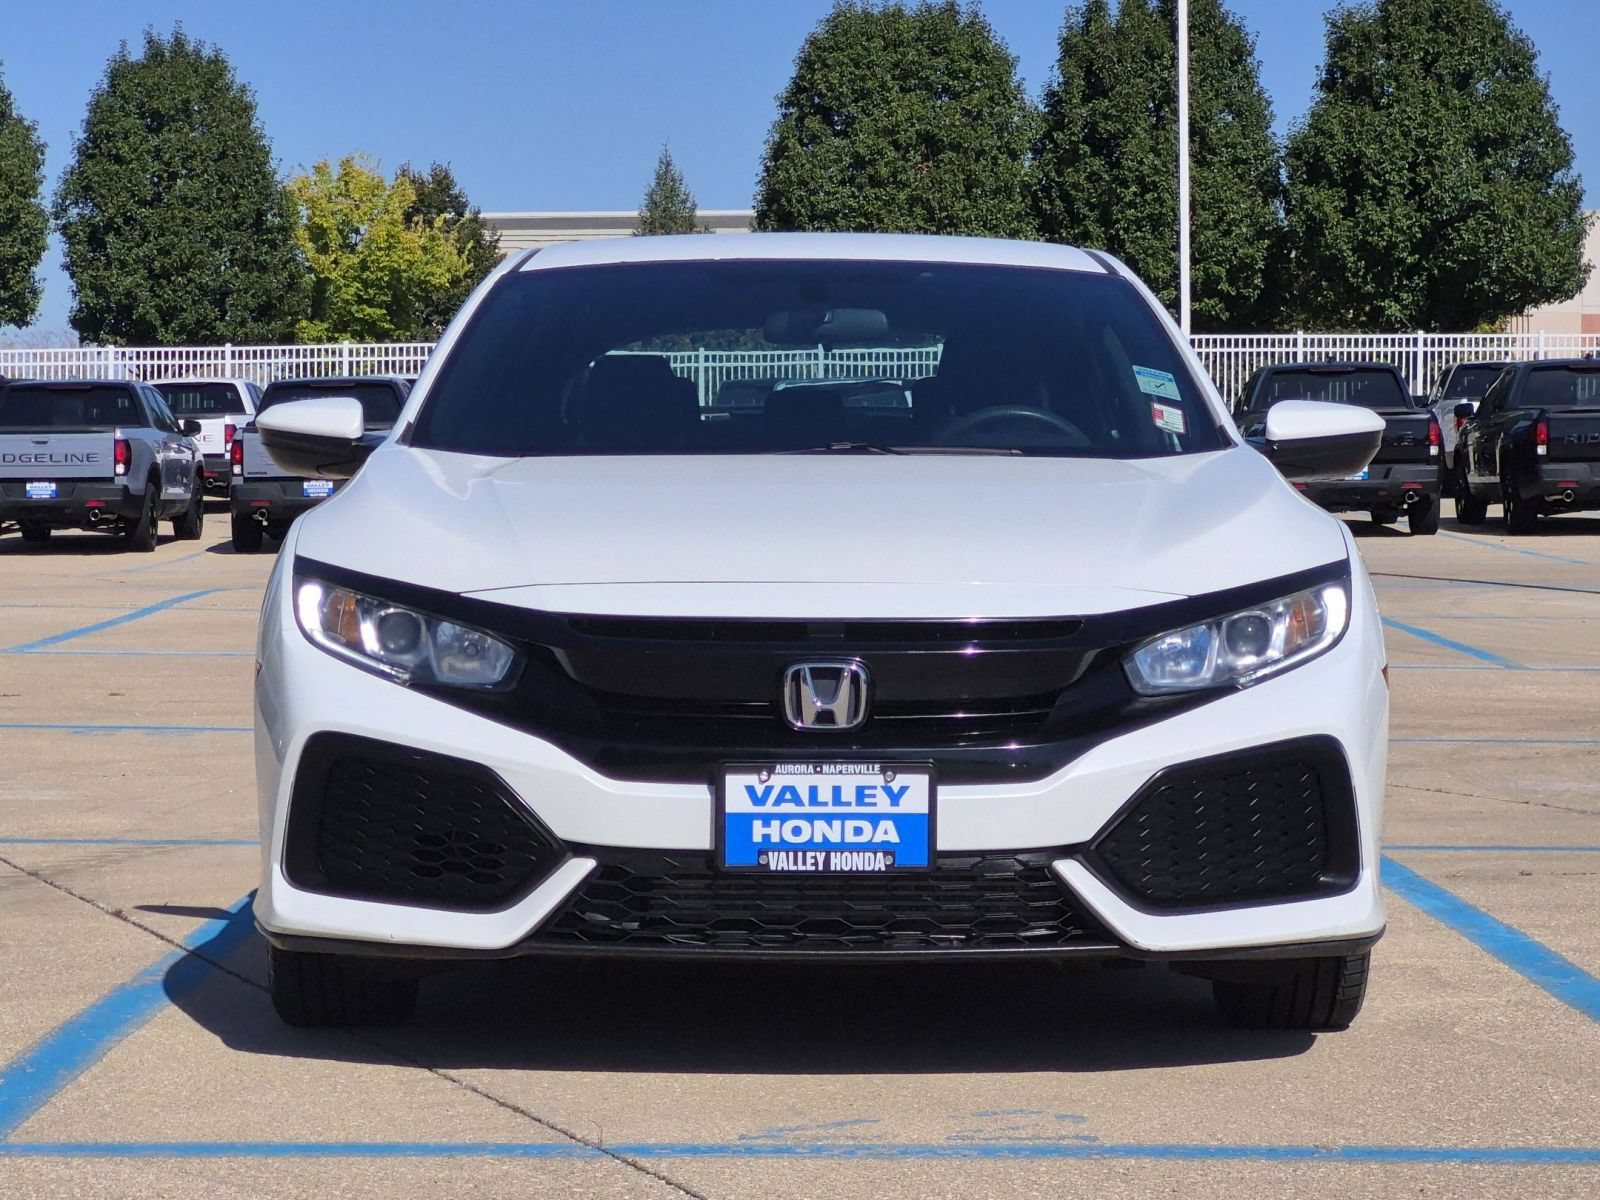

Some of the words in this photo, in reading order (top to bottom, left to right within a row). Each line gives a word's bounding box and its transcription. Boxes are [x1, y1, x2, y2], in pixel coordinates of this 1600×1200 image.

[775, 764, 814, 774] AURORA
[822, 764, 881, 774] NAPERVILLE
[744, 785, 910, 807] VALLEY
[752, 819, 901, 843] HONDA
[767, 851, 826, 871] VALLEY
[830, 851, 886, 871] HONDA
